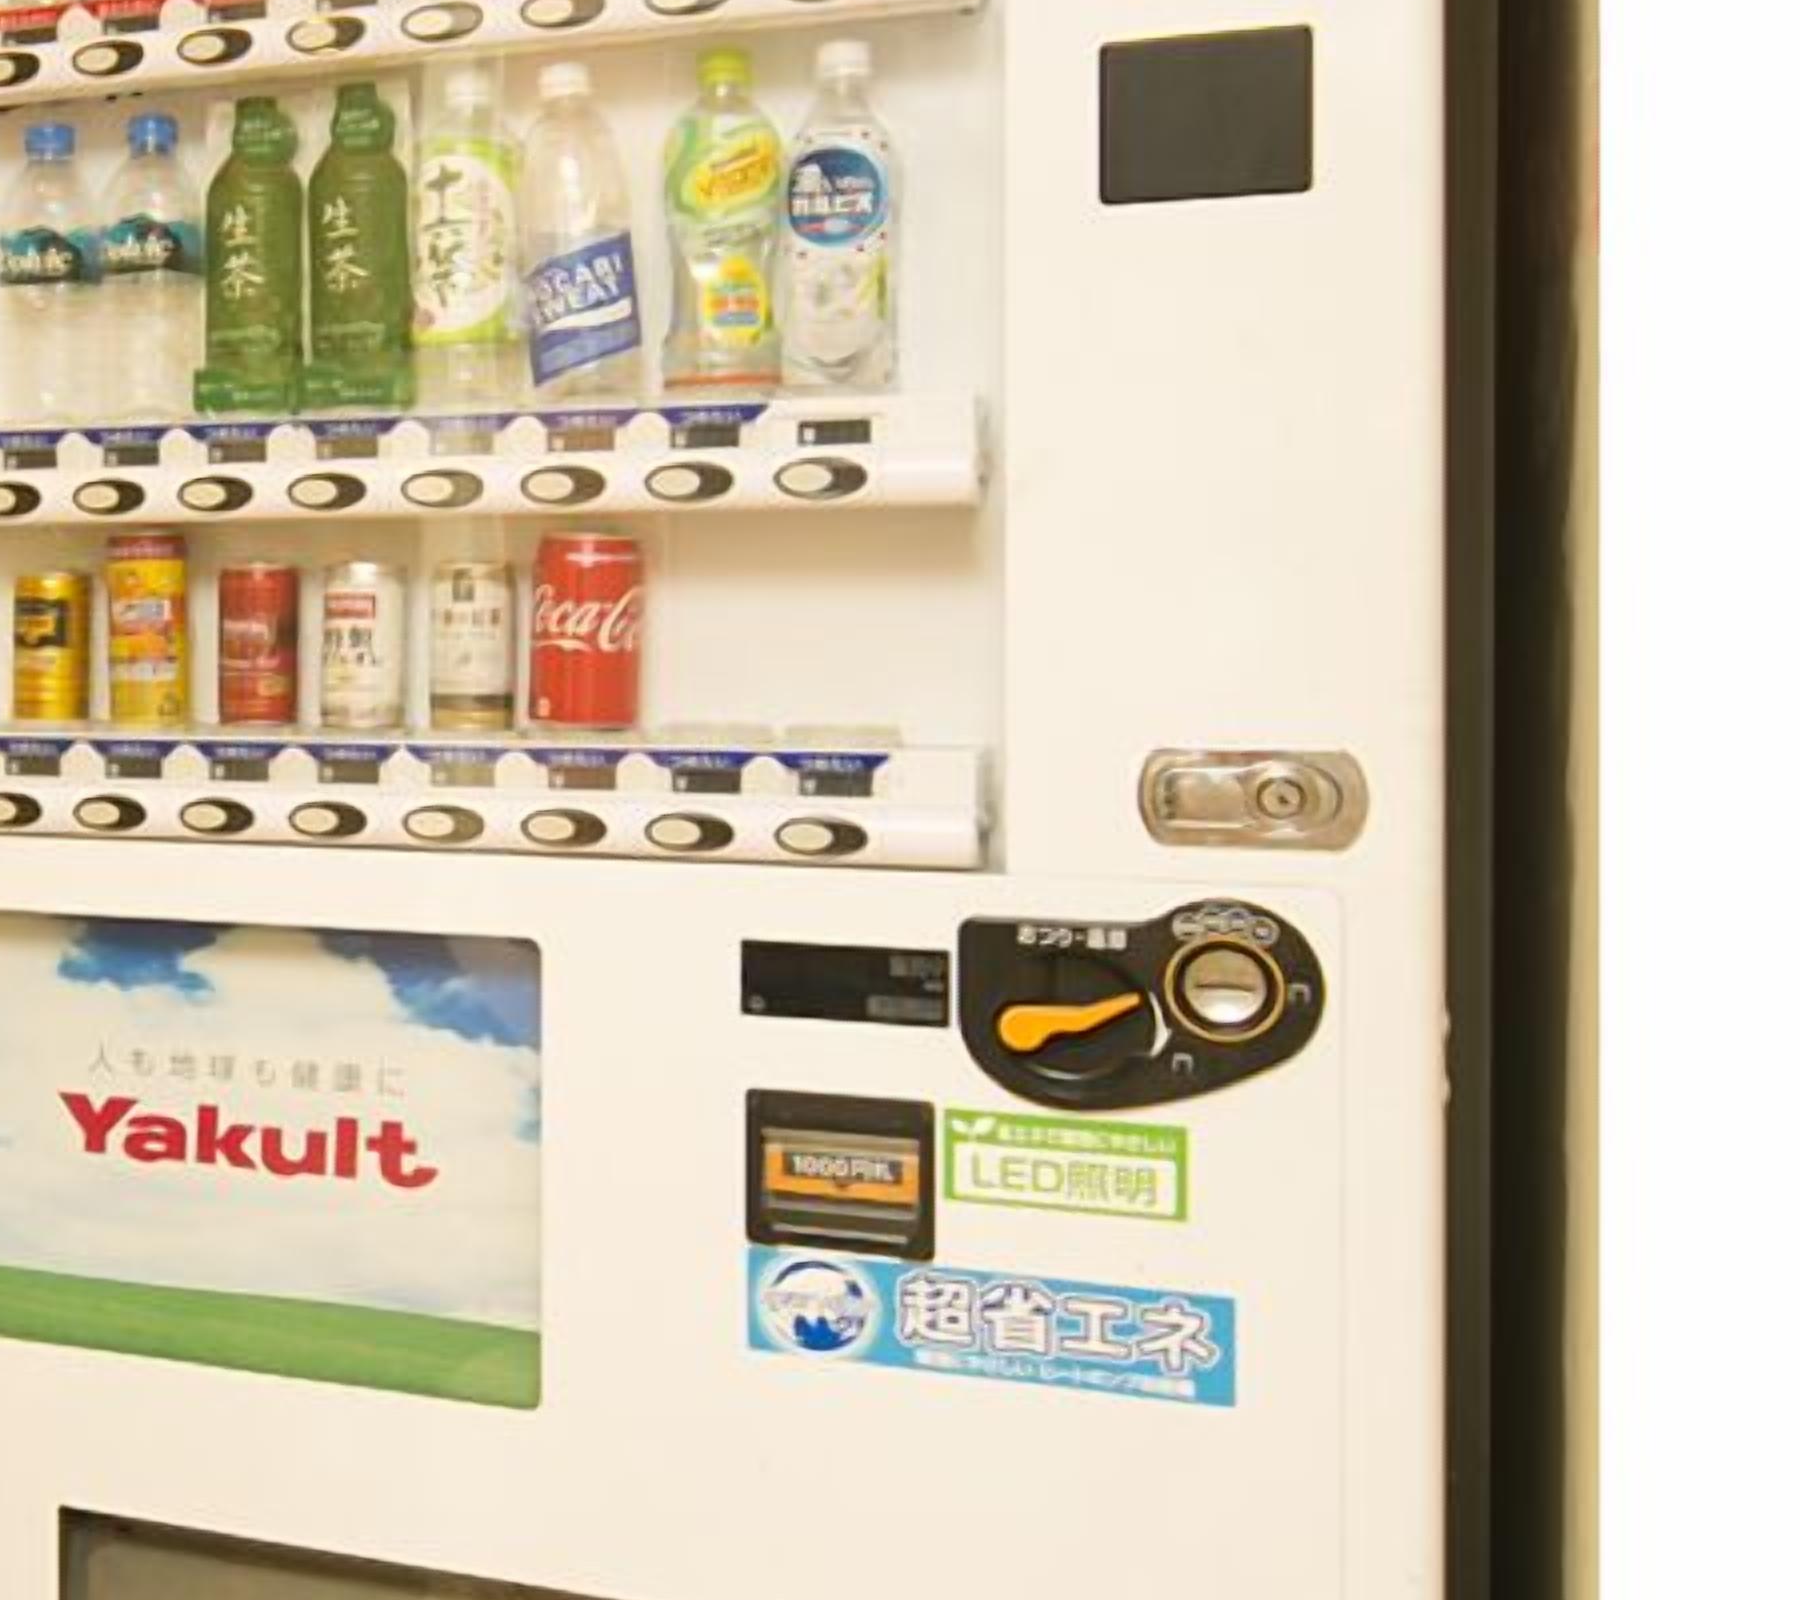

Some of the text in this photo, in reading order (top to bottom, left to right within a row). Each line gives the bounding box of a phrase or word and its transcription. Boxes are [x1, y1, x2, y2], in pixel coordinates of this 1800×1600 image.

[59, 1091, 440, 1189] Yakult
[970, 1153, 1158, 1209] LED照明
[900, 1273, 1218, 1374] 超省エネ
